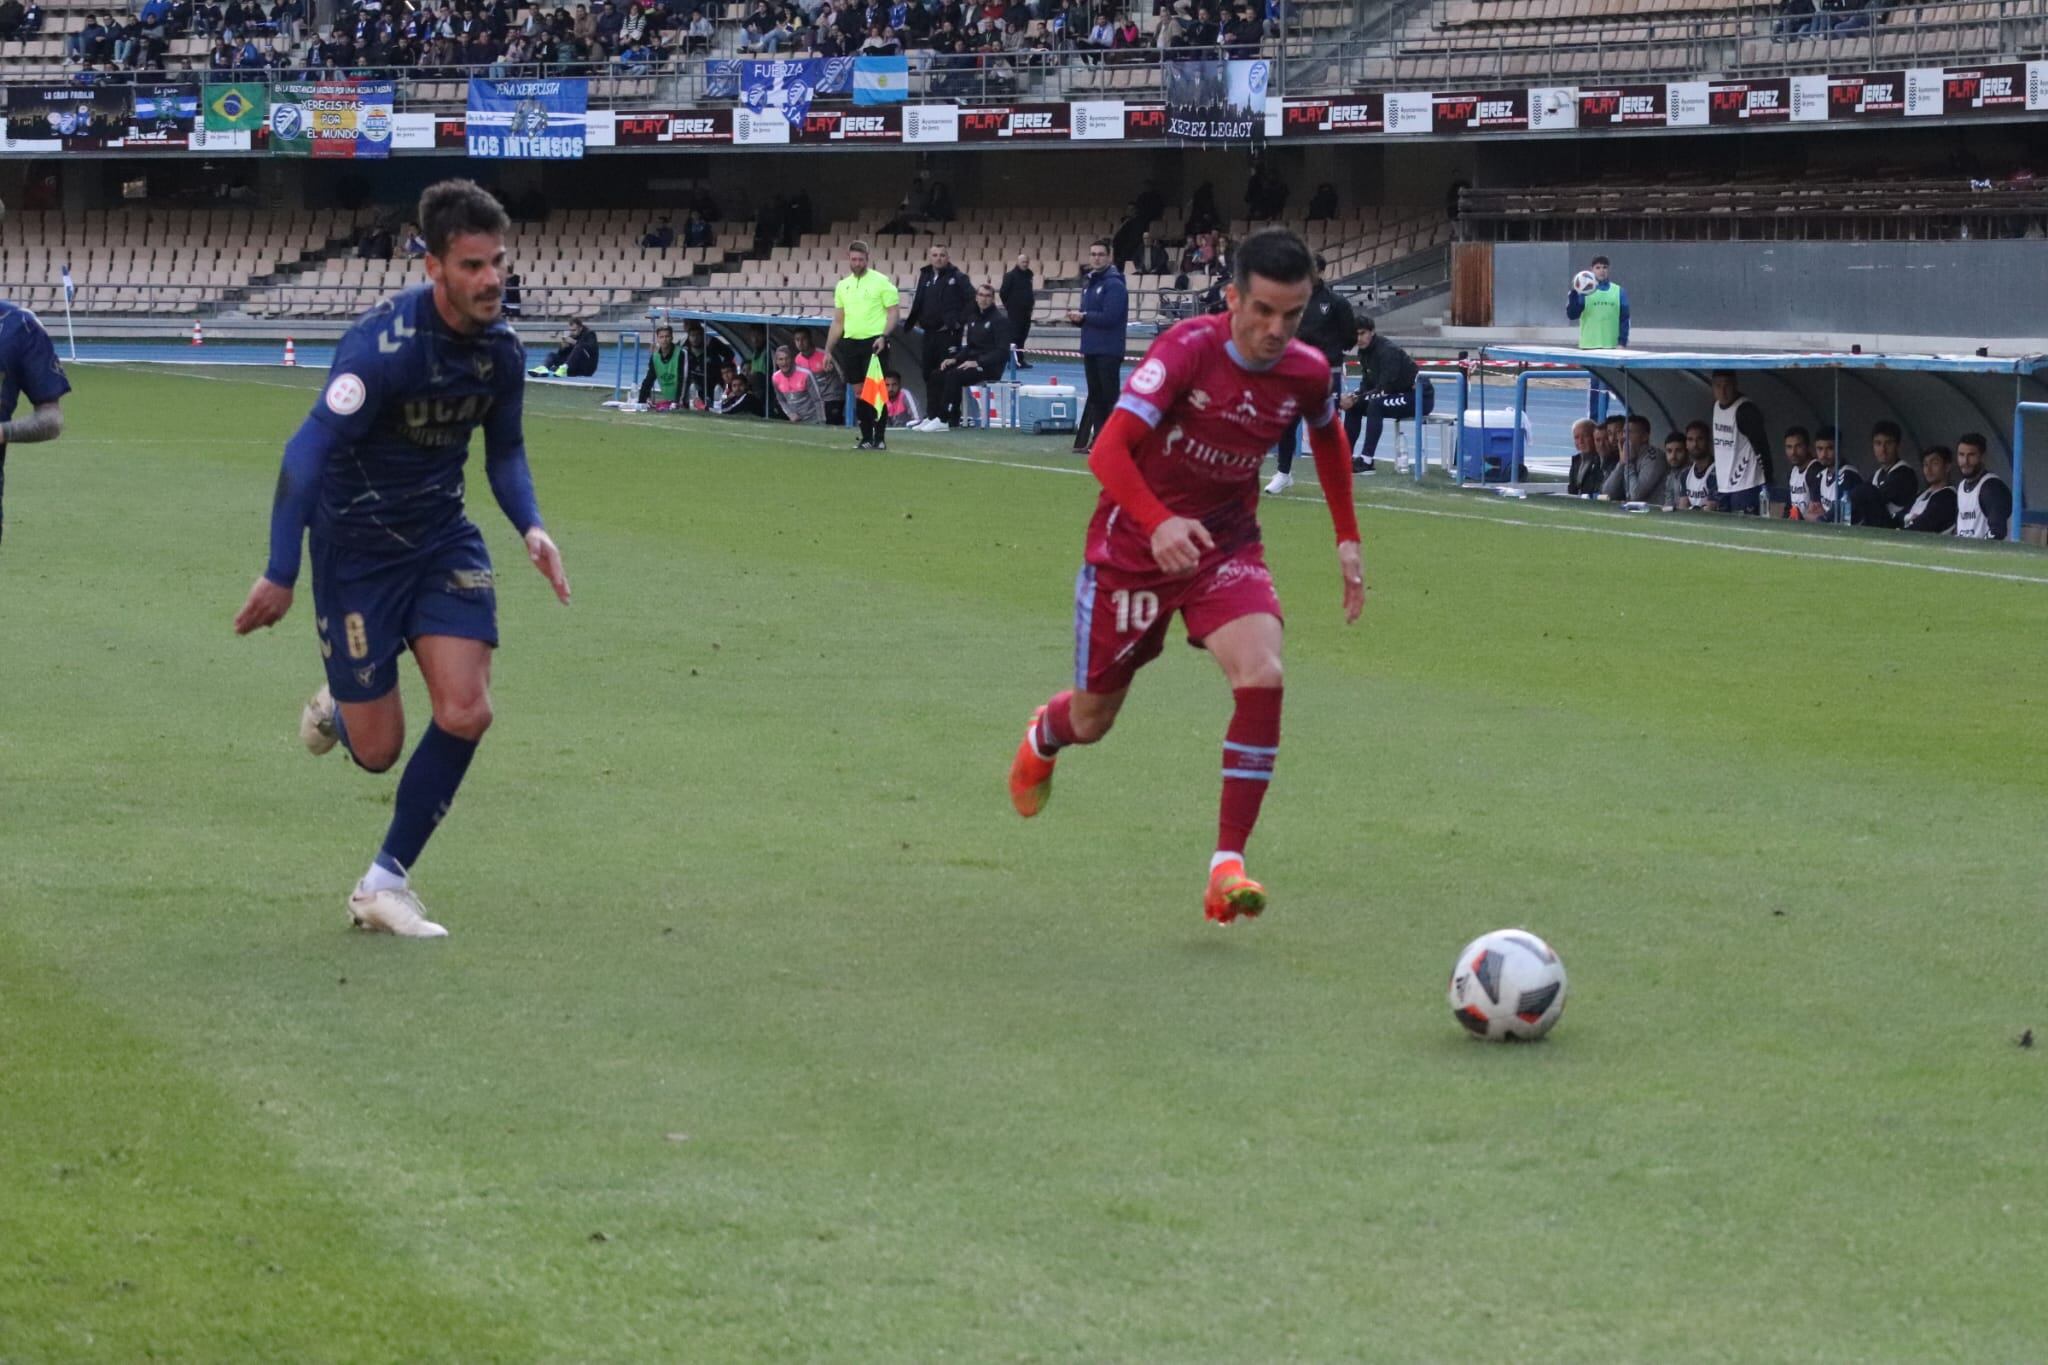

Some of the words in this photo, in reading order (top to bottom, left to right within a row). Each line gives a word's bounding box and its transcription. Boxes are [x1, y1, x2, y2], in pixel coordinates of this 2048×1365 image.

[754, 63, 803, 78] FUERZA
[1855, 84, 1893, 112] JEREZ
[1972, 77, 2012, 107] JEREZ
[301, 100, 364, 111] XERECISTAS
[1438, 103, 1473, 120] PLAY
[1467, 101, 1513, 127] JEREZ
[1583, 97, 1616, 114] PLAY
[1610, 96, 1654, 122] JEREZ
[1739, 90, 1779, 118] JEREZ
[321, 114, 342, 125] POR
[830, 116, 885, 139] JEREZ
[965, 114, 1005, 128] PLAY
[998, 113, 1052, 136] JEREZ
[1289, 107, 1325, 123] PLAY
[1318, 105, 1368, 130] JEREZ
[306, 128, 318, 139] EL
[322, 127, 359, 139] MUNDO
[623, 120, 664, 135] PLAY
[657, 119, 715, 141] JEREZ
[1210, 121, 1253, 138] LEGACY
[468, 135, 499, 156] LOS
[504, 136, 584, 157] INTENSOS
[1111, 589, 1159, 633] 10
